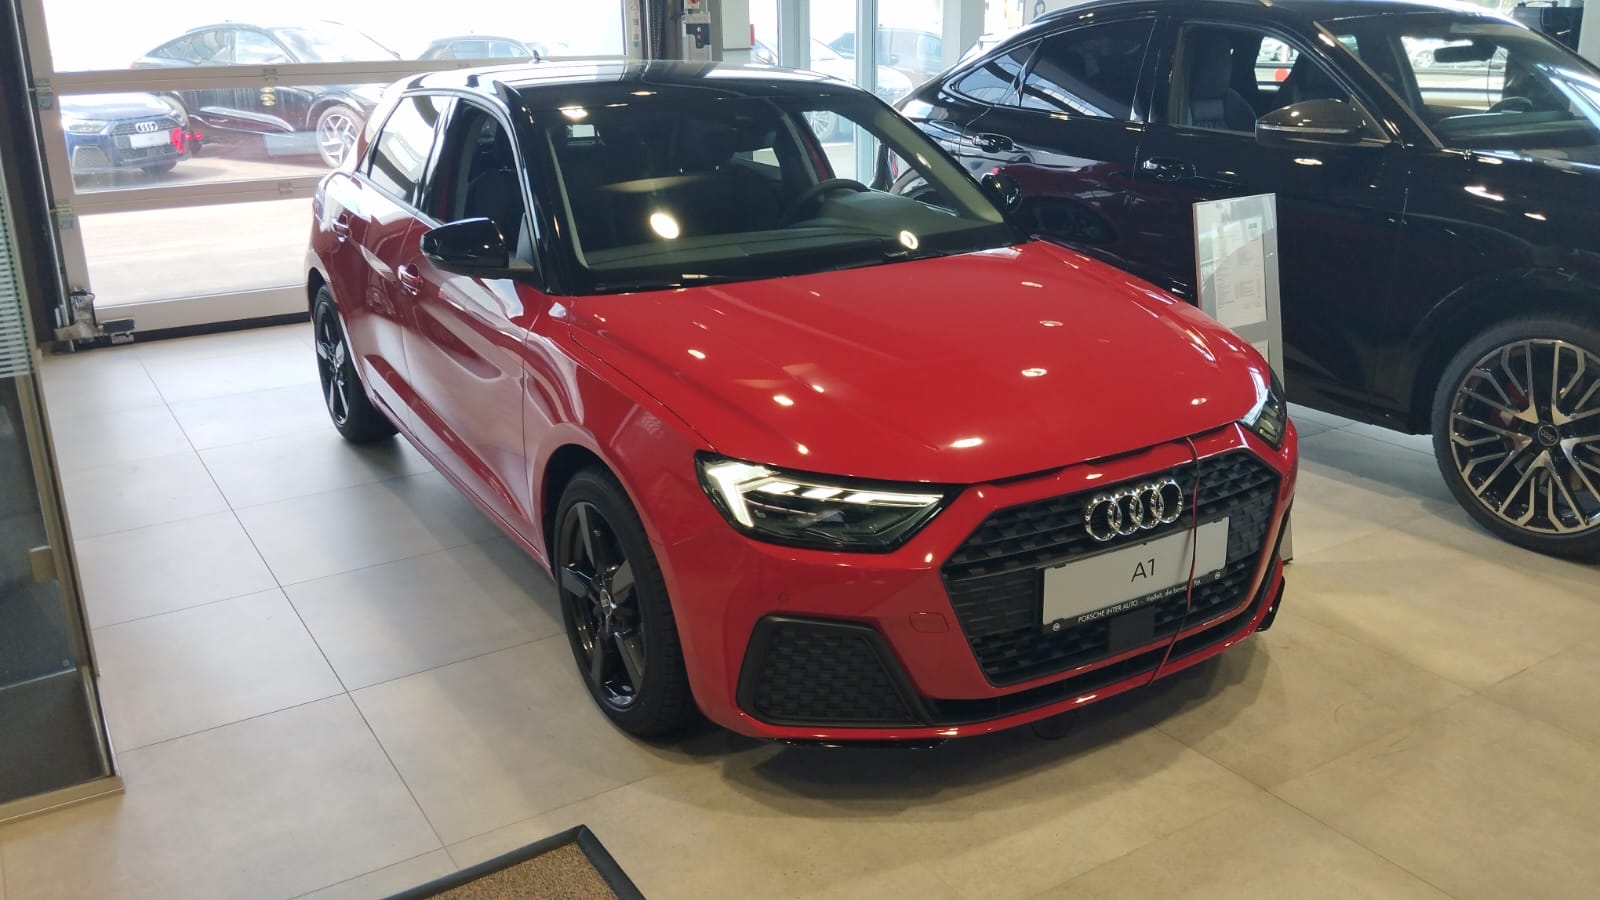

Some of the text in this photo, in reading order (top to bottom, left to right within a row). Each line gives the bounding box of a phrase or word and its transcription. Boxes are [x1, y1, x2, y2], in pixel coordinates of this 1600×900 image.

[1130, 558, 1155, 583] A1
[1078, 609, 1105, 623] PORSCHE
[1106, 604, 1122, 616] INTER
[1122, 599, 1138, 610] AUTO
